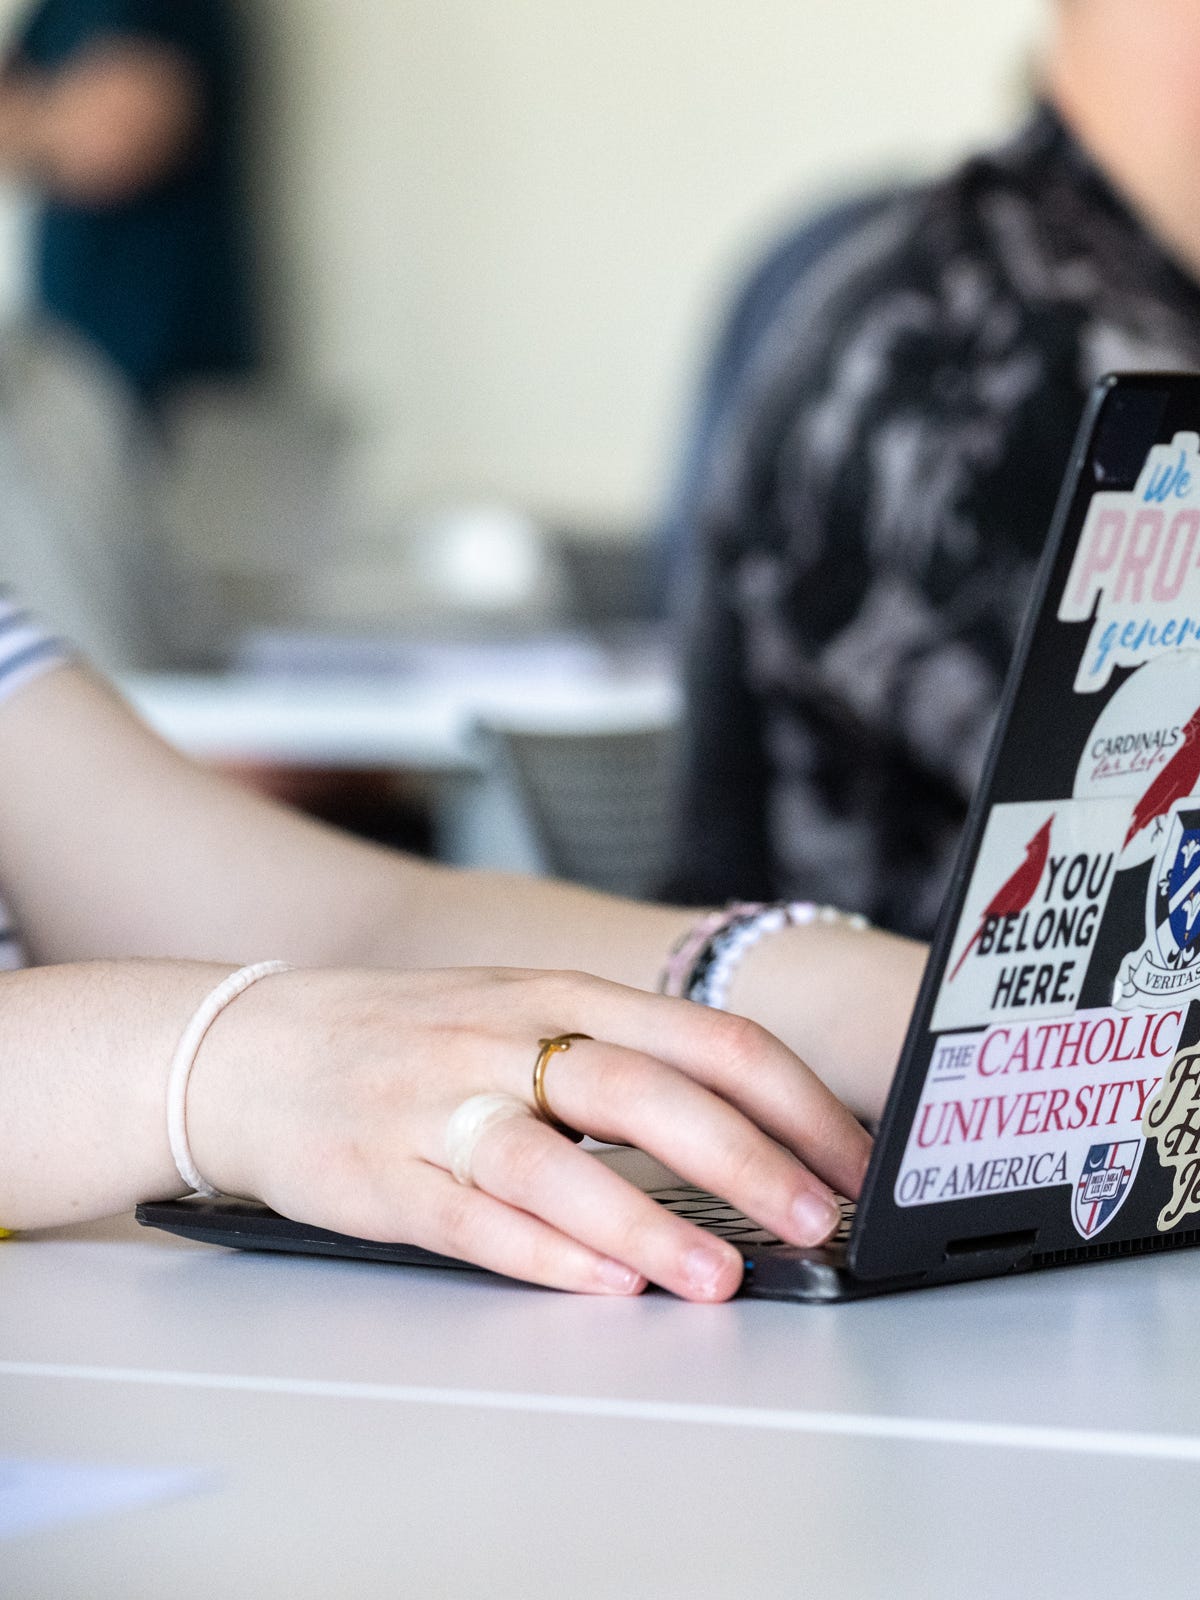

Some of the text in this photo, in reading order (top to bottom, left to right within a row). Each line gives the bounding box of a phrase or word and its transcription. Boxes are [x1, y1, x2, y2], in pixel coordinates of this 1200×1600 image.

[1143, 448, 1192, 503] We
[1091, 726, 1180, 759] CARDINALS
[1044, 852, 1114, 903] YOU
[976, 904, 1099, 956] BELONG
[991, 961, 1076, 1010] HERE.
[937, 1010, 1183, 1078] THE CATHOLIC
[916, 1077, 1162, 1148] UNIVERSITY
[900, 1151, 1067, 1200] OF AMERICA
